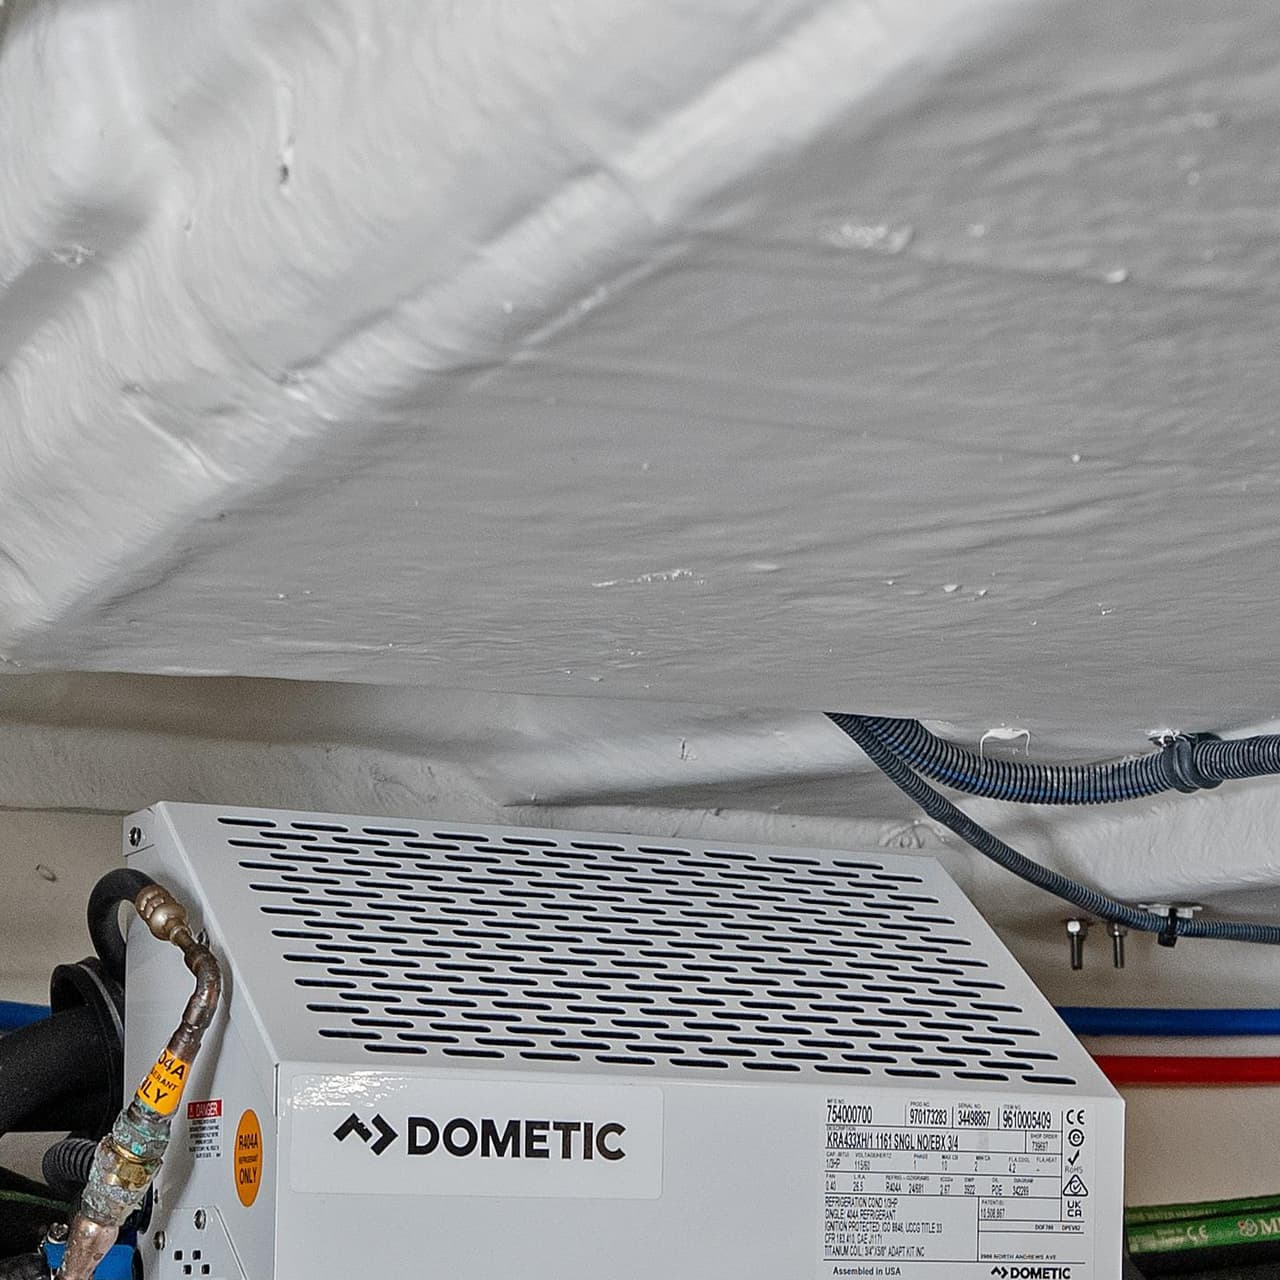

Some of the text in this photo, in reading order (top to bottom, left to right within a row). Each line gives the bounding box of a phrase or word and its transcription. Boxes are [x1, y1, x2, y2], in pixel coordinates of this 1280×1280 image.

[826, 1105, 873, 1124] 754000700
[909, 1109, 948, 1125] 970173283
[958, 1110, 991, 1126] 34498867
[1003, 1110, 1052, 1129] 9610005409
[1066, 1109, 1085, 1125] CE
[238, 1133, 258, 1150] R404A
[407, 1116, 627, 1161] DOMETIC
[876, 1133, 892, 1150] 1161
[894, 1134, 915, 1150] SNGL
[947, 1135, 958, 1151] 3/4
[239, 1168, 258, 1185] ONLY
[833, 1267, 874, 1276] Assembled
[885, 1267, 901, 1276] USA
[1010, 1267, 1071, 1279] DOMETIC
